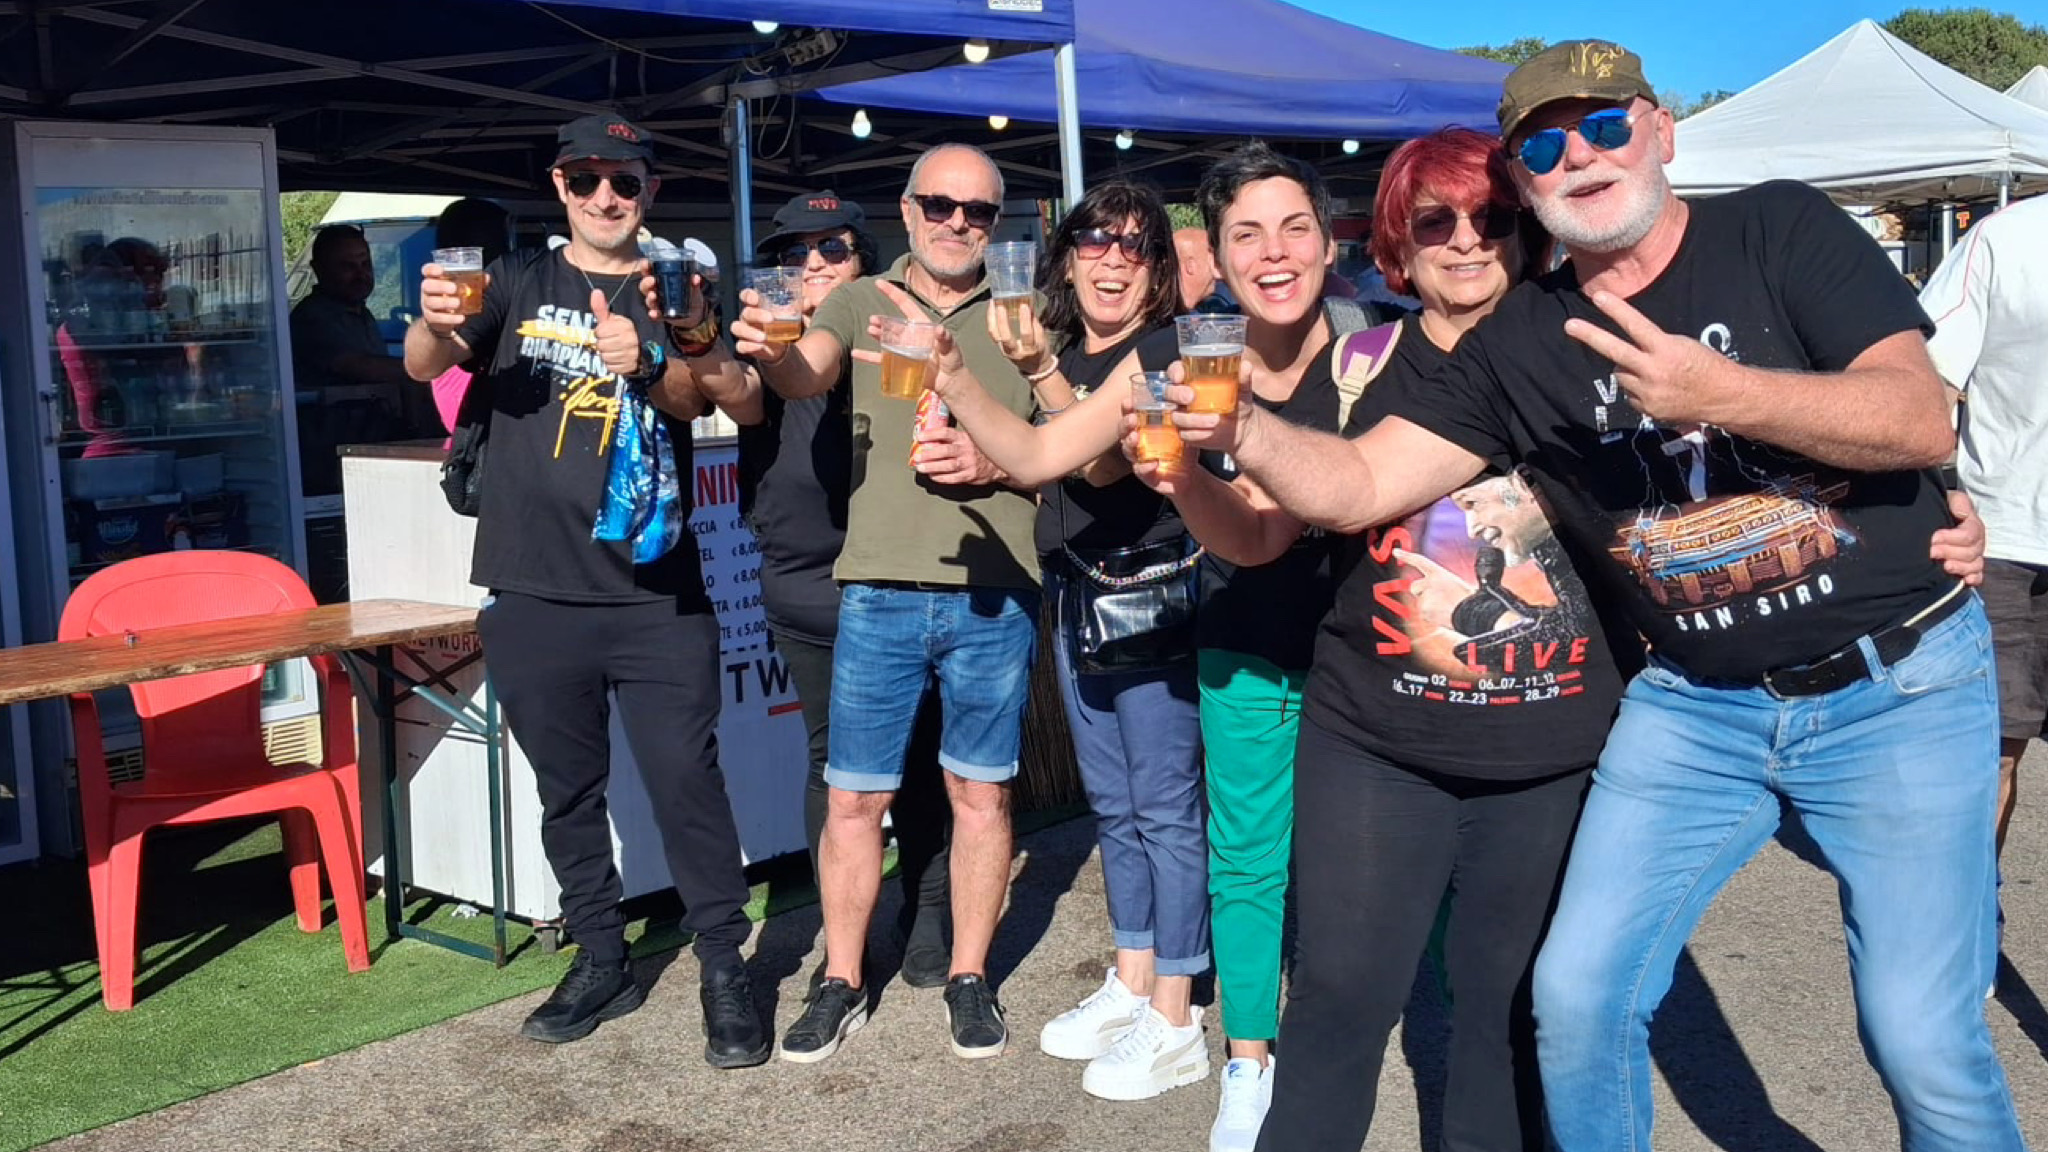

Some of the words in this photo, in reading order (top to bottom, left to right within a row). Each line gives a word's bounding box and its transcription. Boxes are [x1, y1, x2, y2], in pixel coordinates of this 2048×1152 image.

[537, 304, 598, 341] SEN
[520, 336, 608, 377] RIMPIAN
[689, 520, 717, 535] CCIA
[1675, 606, 1734, 631] SAN
[1757, 573, 1834, 616] SIRO
[1467, 636, 1590, 673] LIVE
[1431, 674, 1447, 687] 02
